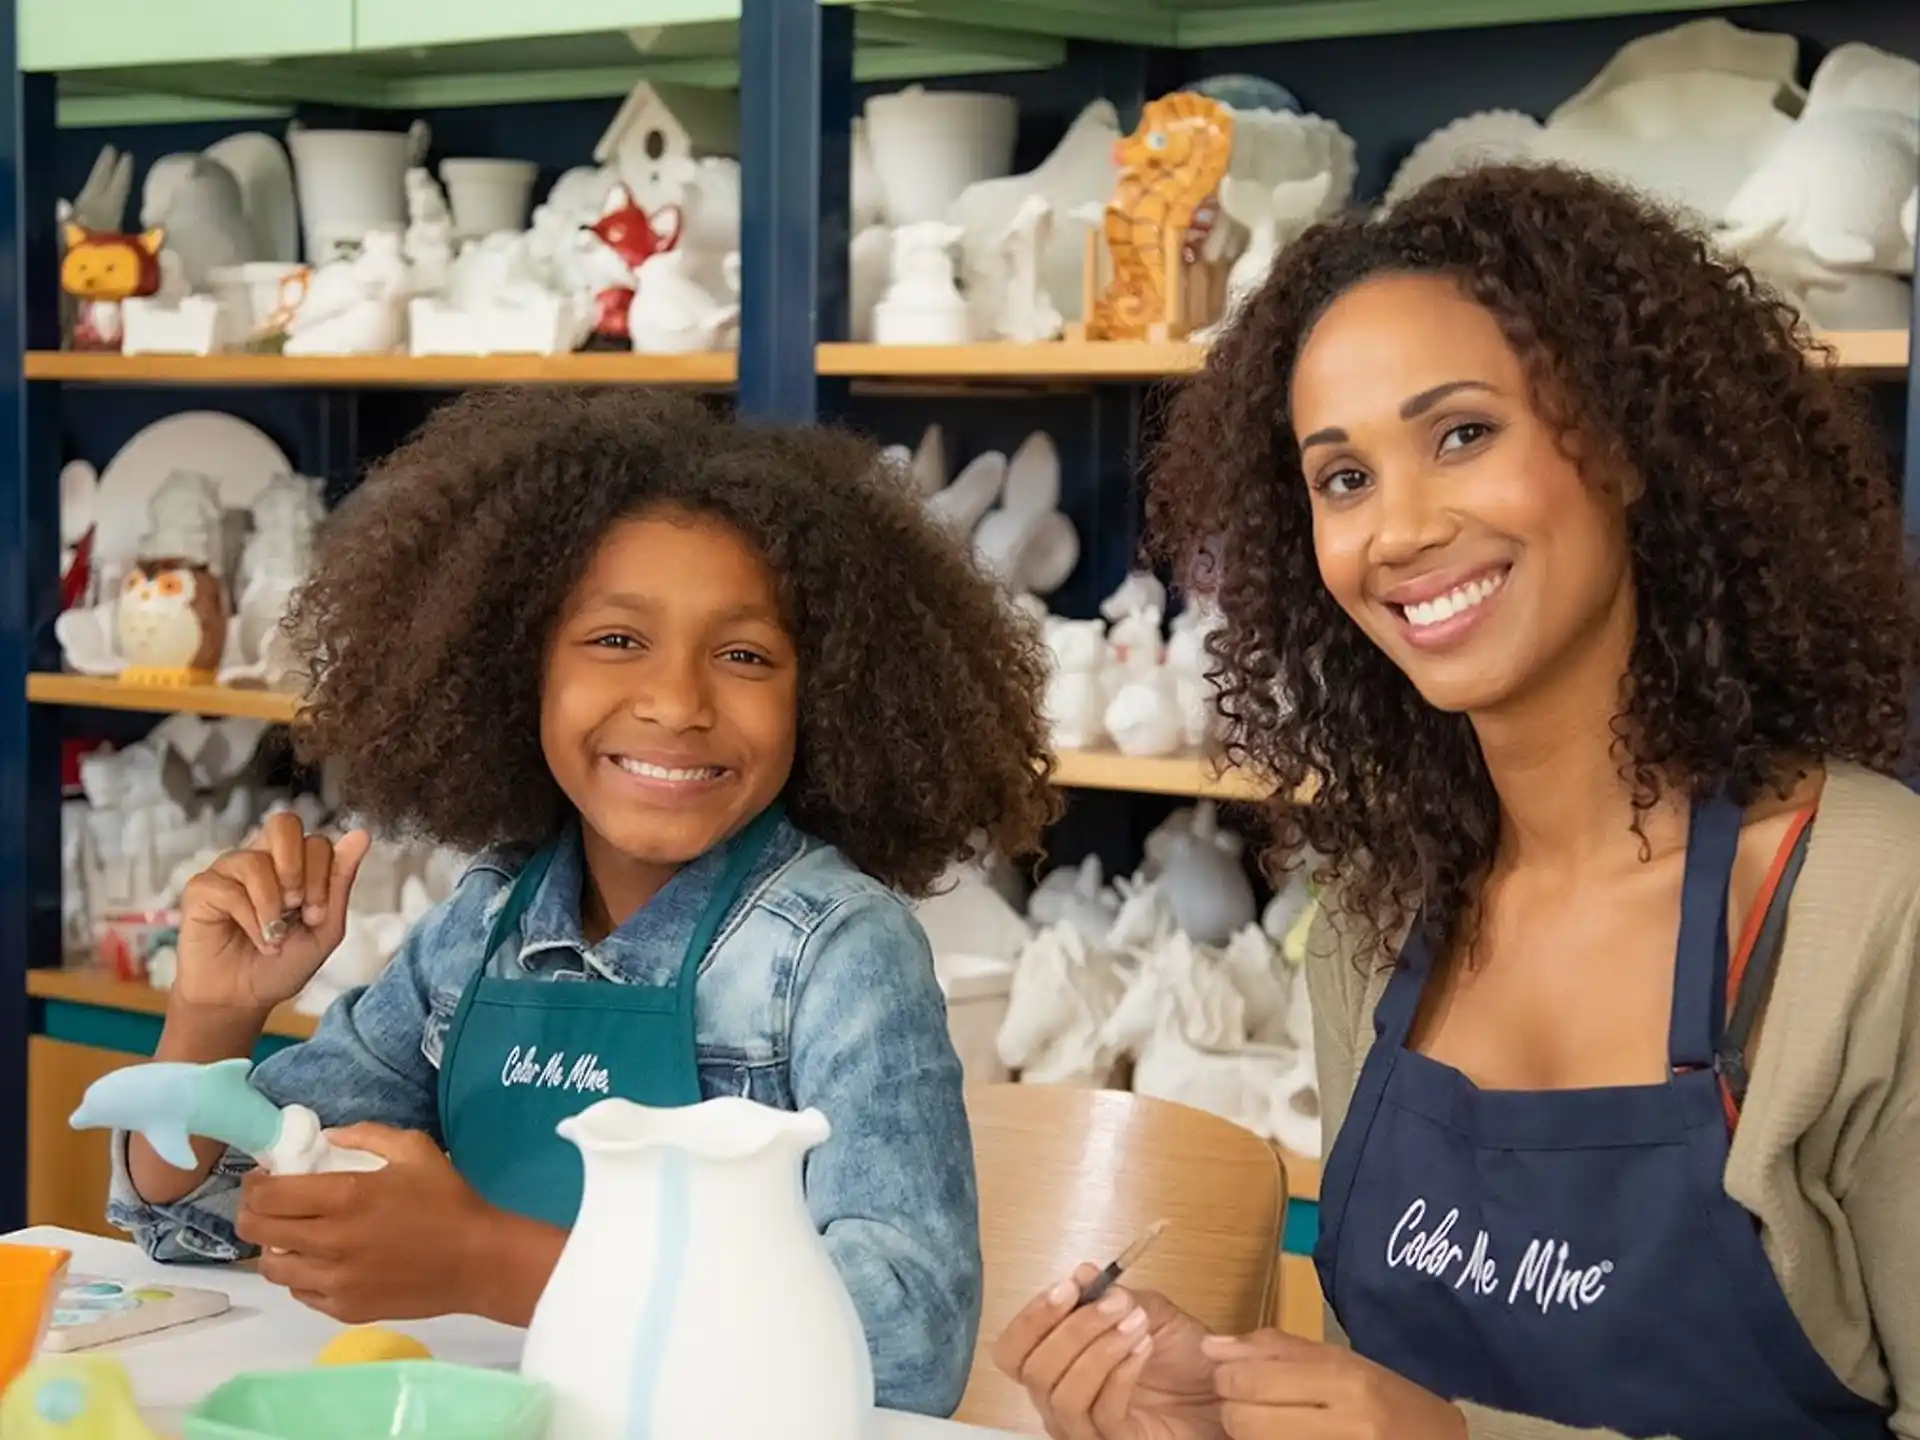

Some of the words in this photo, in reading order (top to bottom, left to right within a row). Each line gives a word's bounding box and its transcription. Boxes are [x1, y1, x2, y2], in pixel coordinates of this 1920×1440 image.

[502, 1045, 540, 1087] Color
[535, 1051, 564, 1088] Me
[1387, 1197, 1463, 1276] Color
[1453, 1229, 1499, 1296] Me
